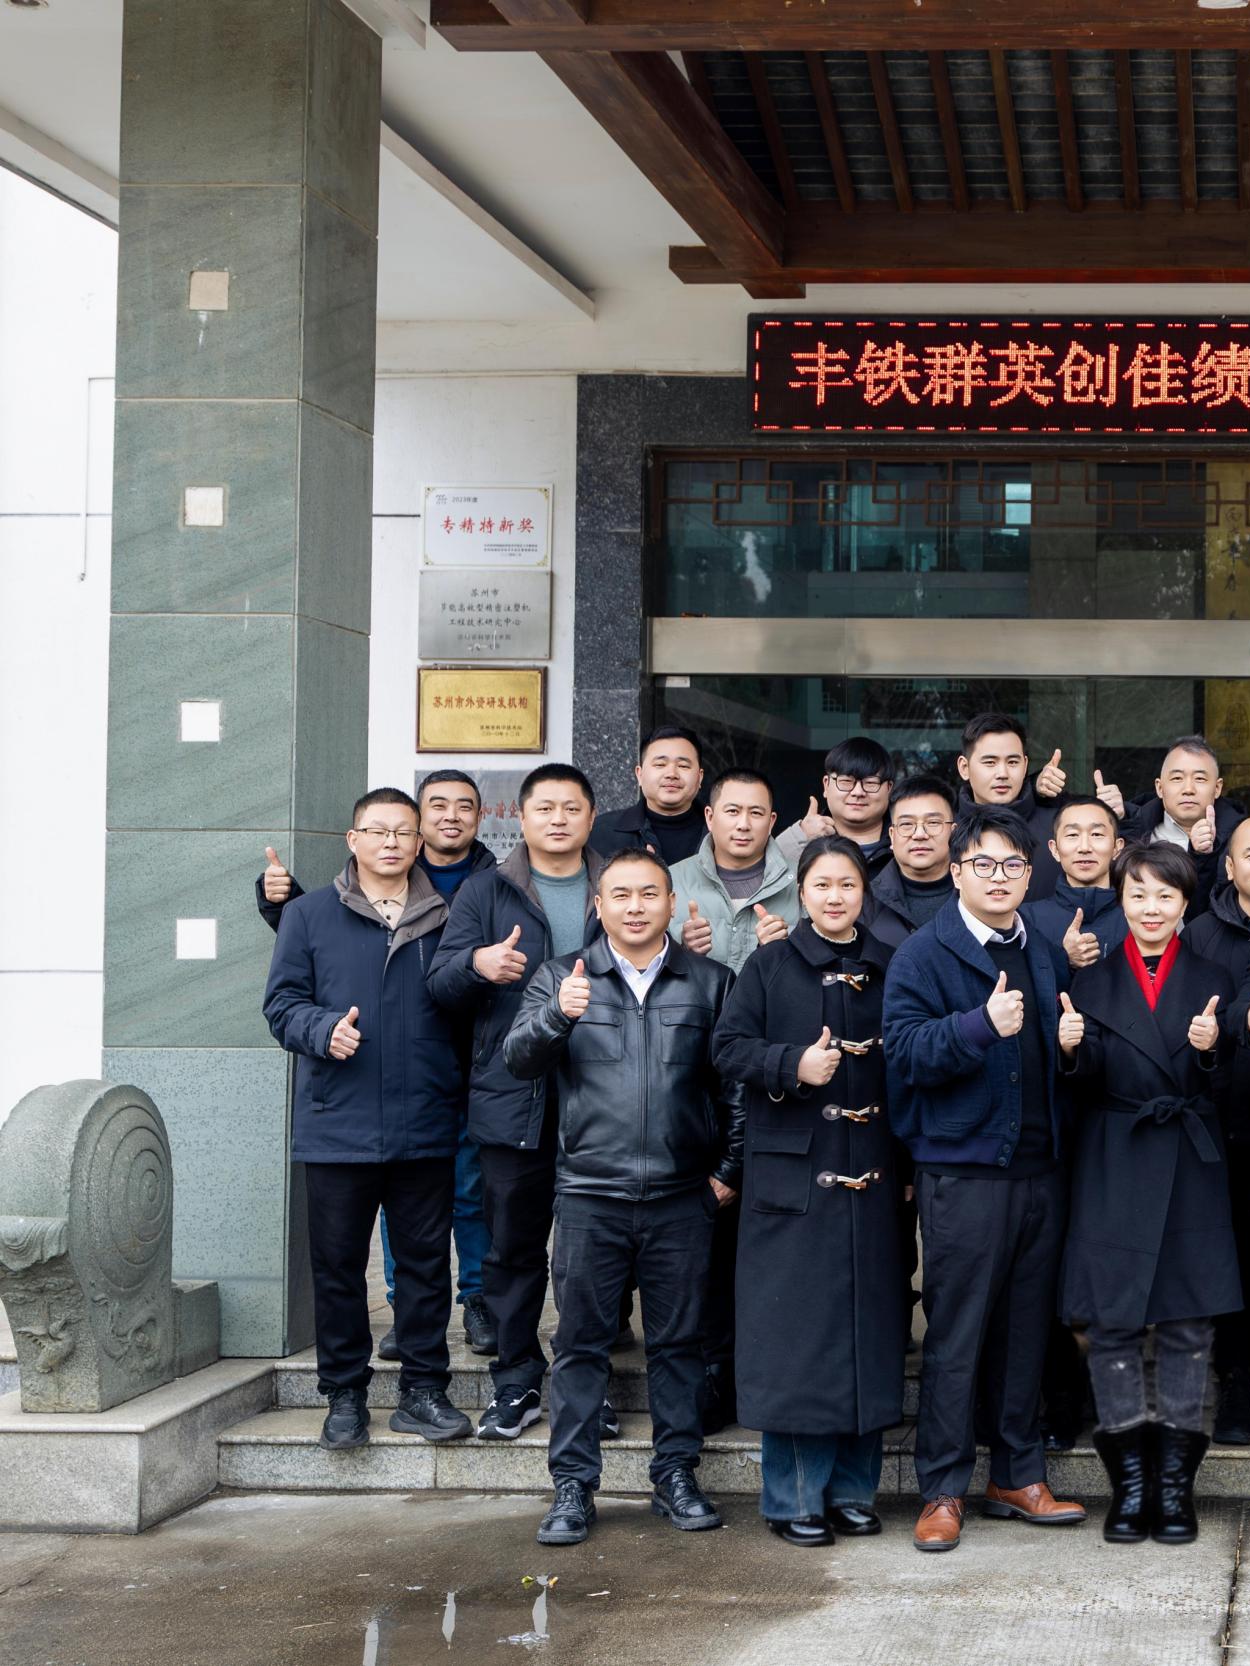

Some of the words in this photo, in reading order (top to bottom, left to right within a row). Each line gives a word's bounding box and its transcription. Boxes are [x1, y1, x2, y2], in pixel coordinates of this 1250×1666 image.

[440, 515, 535, 535] 专精特新奖
[470, 588, 500, 598] 苏州市
[448, 617, 522, 628] 工程技术研究中心
[432, 696, 529, 709] 苏州市外资研发机构
